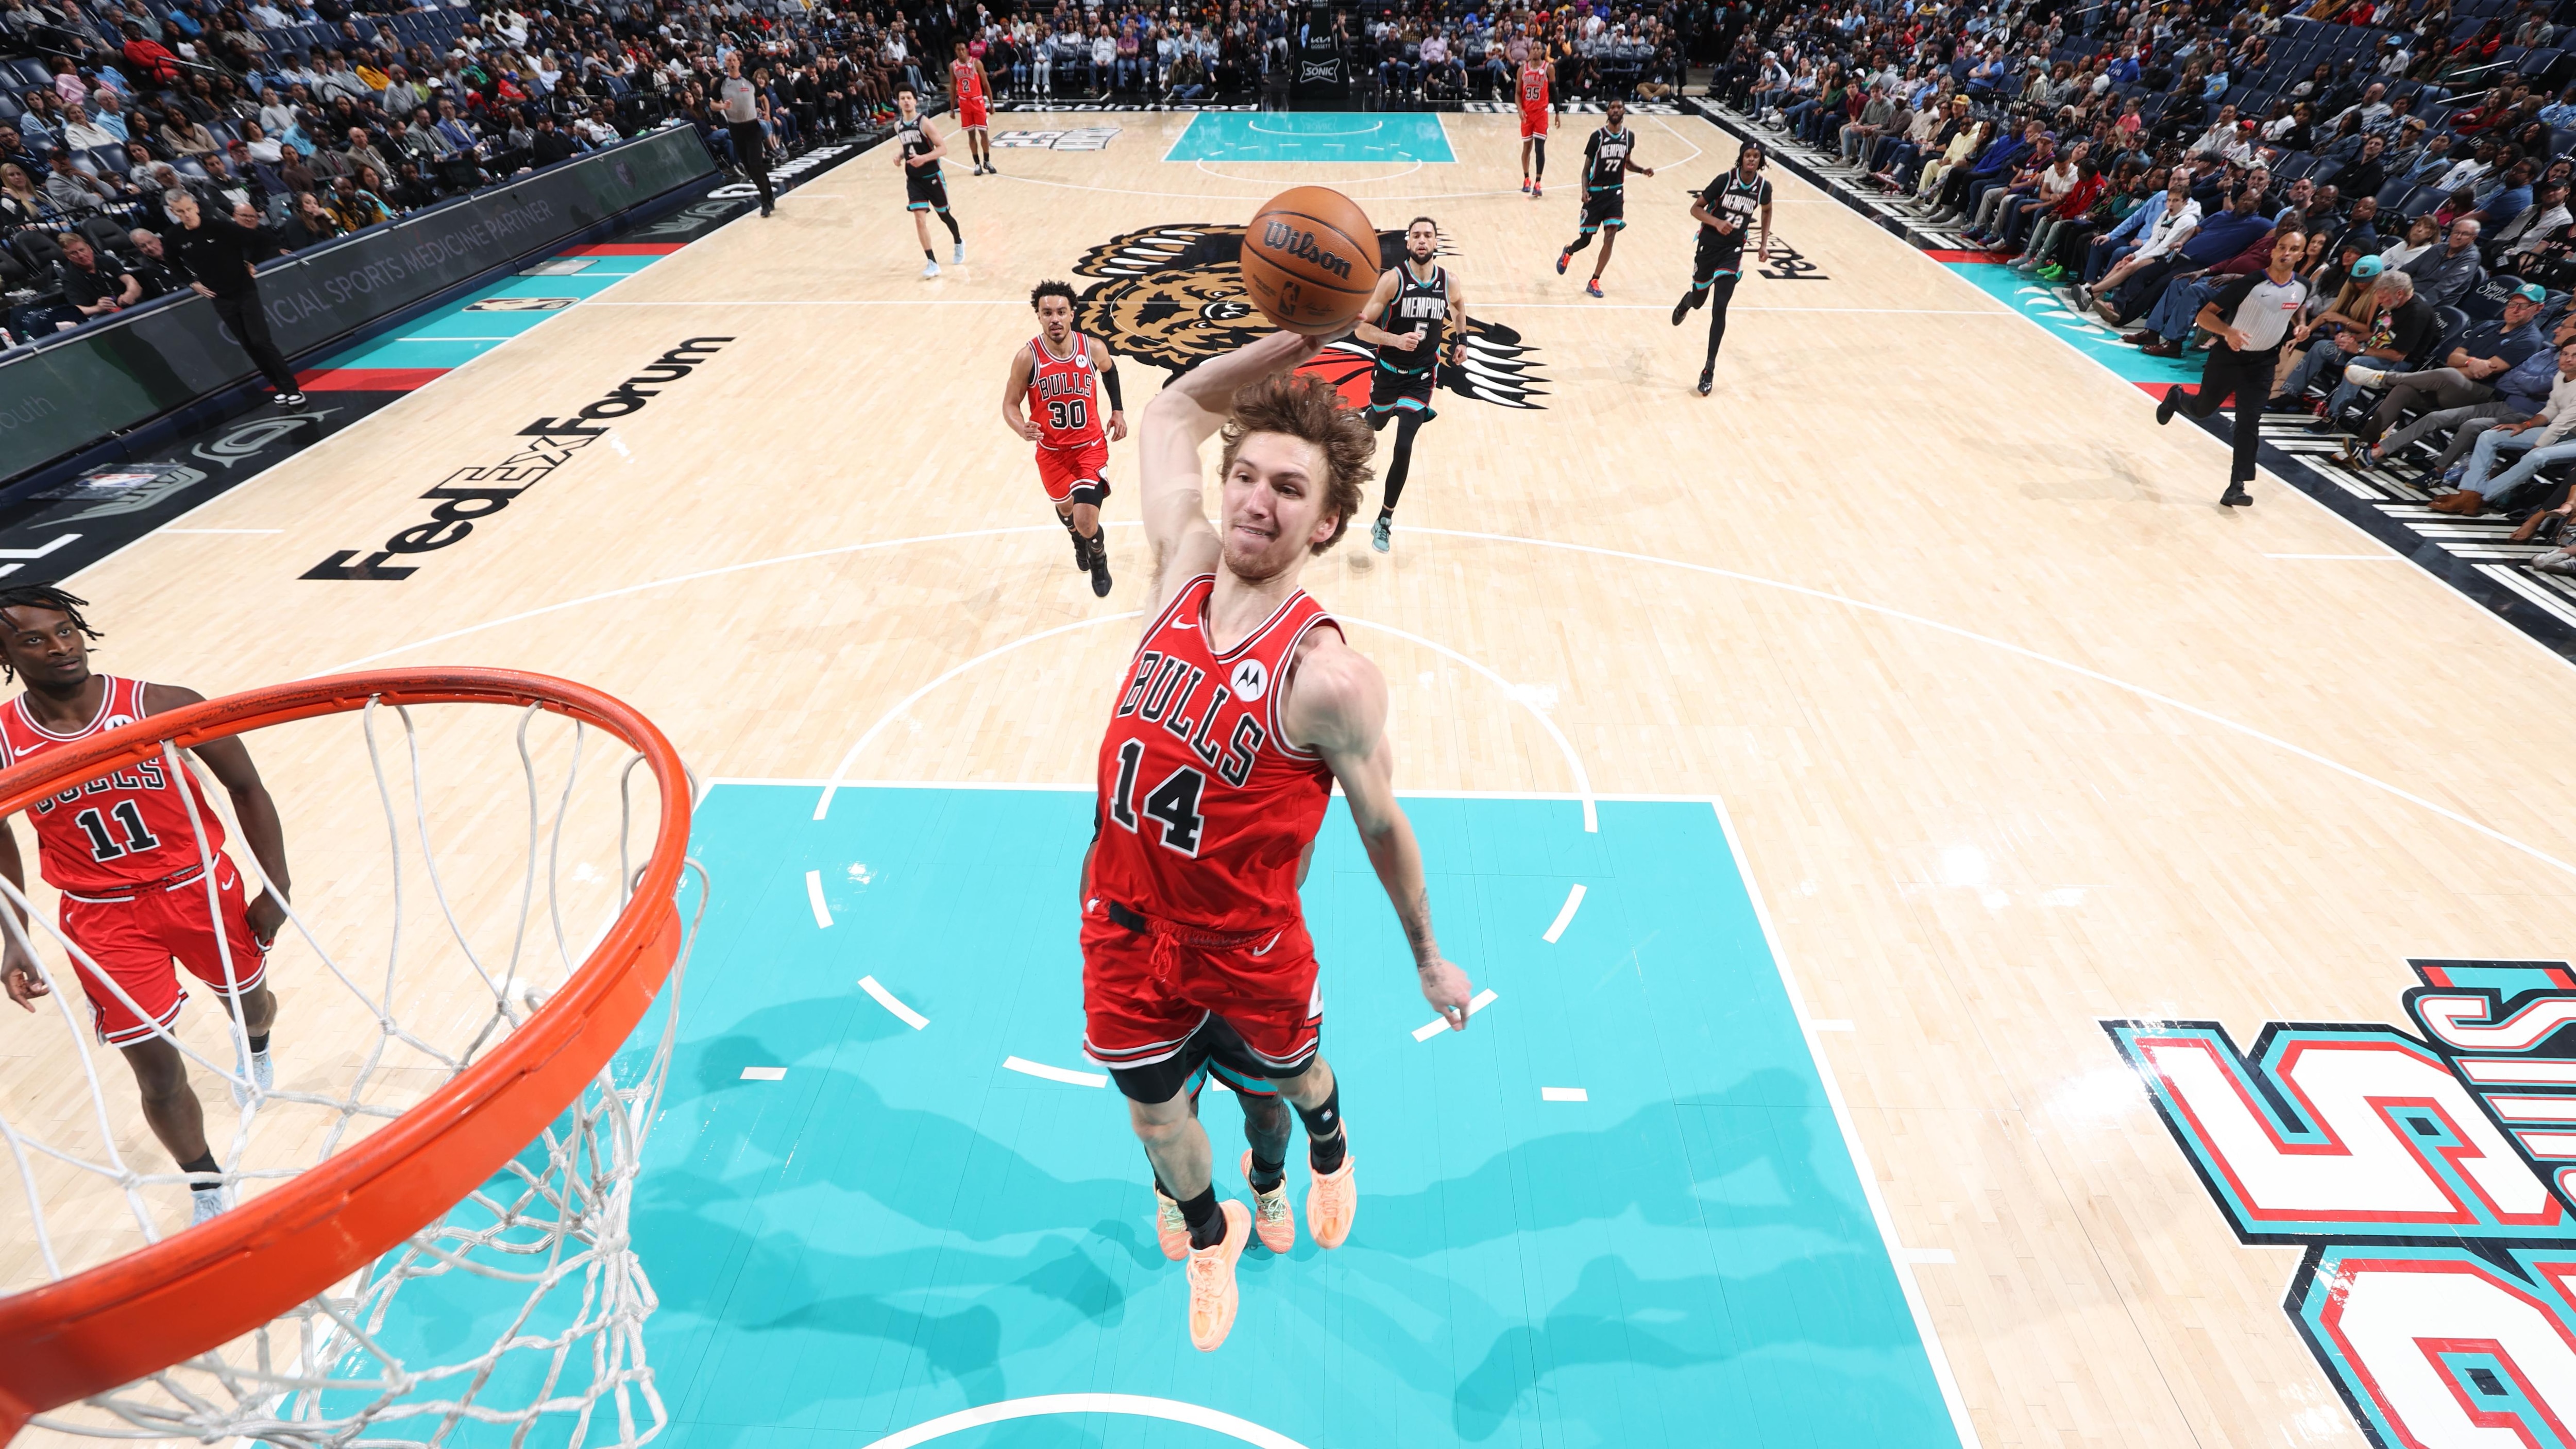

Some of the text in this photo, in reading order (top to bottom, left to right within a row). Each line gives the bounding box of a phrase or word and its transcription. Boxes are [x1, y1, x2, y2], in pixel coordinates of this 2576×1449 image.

[1305, 66, 1334, 76] SONIC
[962, 79, 971, 93] 2
[1526, 87, 1540, 100] 35
[1462, 103, 1683, 114] GRZLES
[908, 144, 917, 156] 4
[1601, 144, 1626, 159] MEMPHIS
[1604, 159, 1621, 172] 77
[1721, 194, 1756, 214] MEMPHIS
[1725, 211, 1744, 229] 72
[1263, 220, 1352, 281] Wilson
[217, 200, 555, 346] ICIAL SPORTS MEDICINE PARTNER
[1401, 297, 1446, 320] MEMPHIS
[1414, 321, 1430, 342] 5
[1038, 372, 1093, 401] BULLS
[0, 396, 58, 436] outh
[1047, 399, 1087, 430] 30
[296, 336, 737, 581] FedExForum
[1115, 650, 1267, 789] BULLS
[1110, 737, 1206, 859] 14
[74, 798, 161, 863] 11
